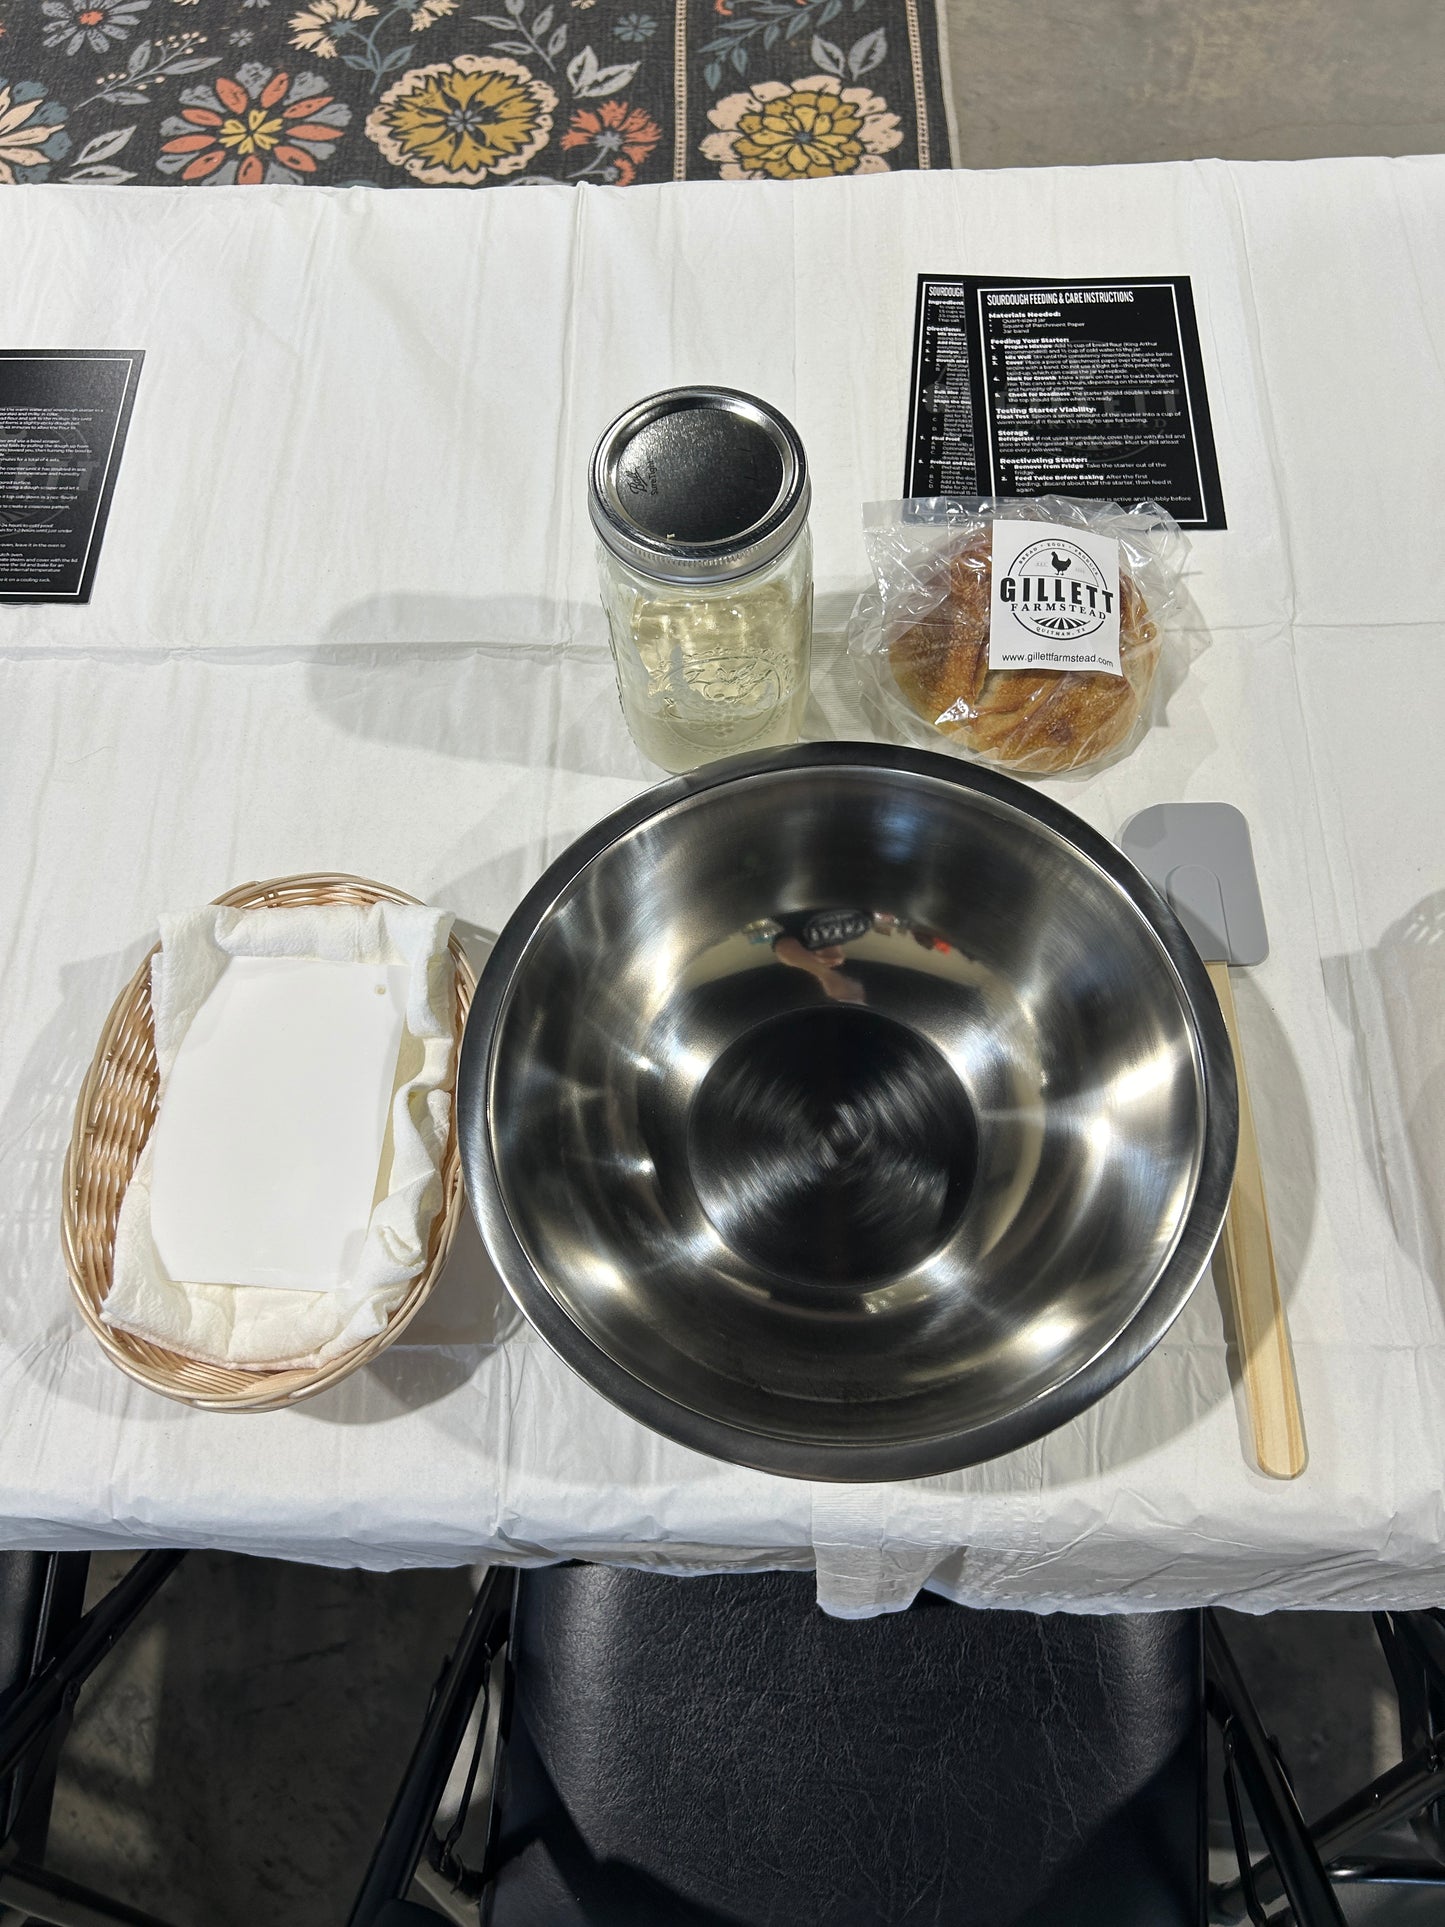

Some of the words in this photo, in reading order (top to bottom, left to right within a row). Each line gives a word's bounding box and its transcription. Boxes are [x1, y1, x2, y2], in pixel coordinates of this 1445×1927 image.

[987, 294, 1028, 306] SOURDOUGH
[1029, 293, 1057, 305] FEEDING
[1058, 293, 1064, 304] &
[1065, 292, 1082, 304] CARE
[1083, 291, 1134, 304] INSTRUCTIONS
[625, 468, 648, 494] Ball
[1019, 547, 1037, 564] BREAD
[1001, 577, 1113, 613] GILLETT
[1011, 603, 1106, 620] FARMSTEAD
[1002, 652, 1113, 667] www.gillettfarmstead.com
